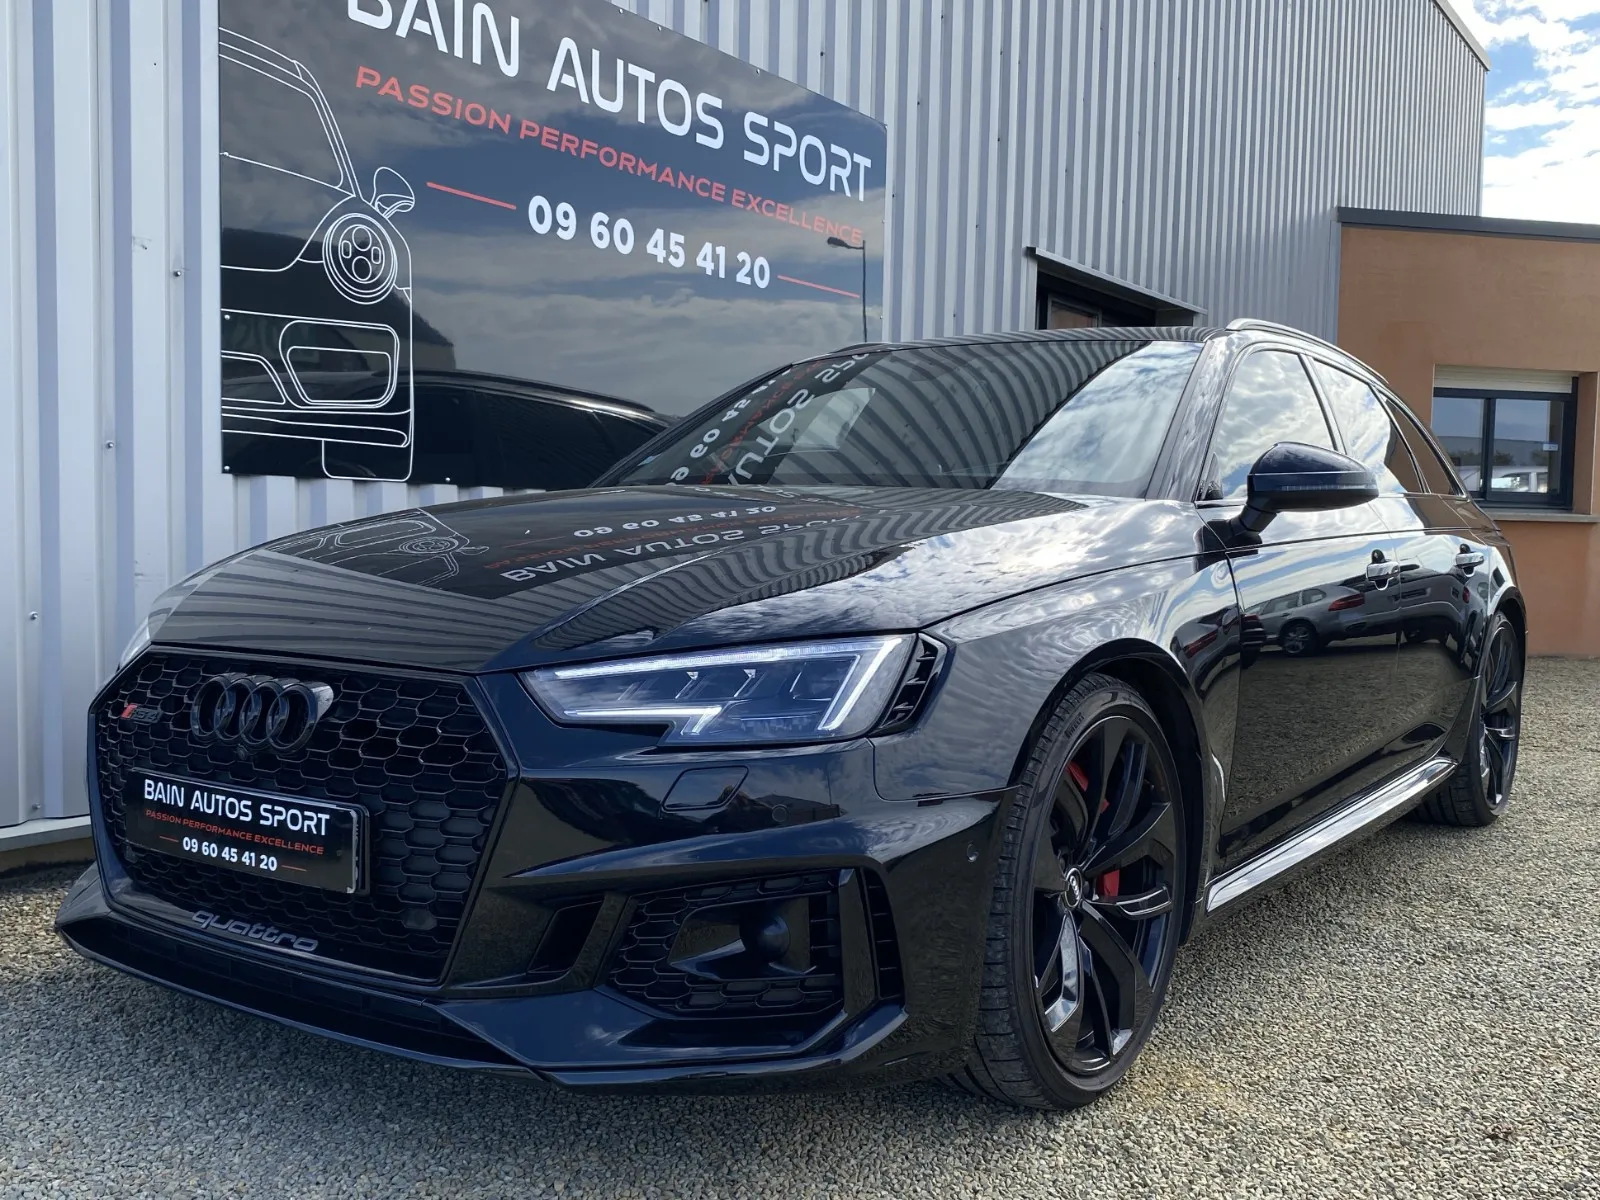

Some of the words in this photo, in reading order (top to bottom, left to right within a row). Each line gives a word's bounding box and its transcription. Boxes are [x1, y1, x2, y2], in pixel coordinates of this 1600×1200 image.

[546, 37, 725, 149] AUTOS
[743, 111, 872, 202] SPORT
[355, 66, 512, 134] PASSION
[519, 119, 726, 203] PERFORMANCE
[731, 188, 864, 246] EXCELLENCE
[528, 195, 577, 241] 09
[590, 211, 635, 255] 60
[646, 228, 685, 268] 45
[696, 241, 726, 279] 41
[736, 251, 770, 289] 20
[143, 779, 185, 808] BAIN
[190, 789, 253, 822] AUTOS
[259, 803, 331, 836] SPORT
[145, 809, 182, 825] PASSION
[182, 818, 252, 841] PERFORMANCE
[254, 834, 325, 855] EXCELLENCE
[182, 836, 199, 853] 09
[201, 841, 218, 858] 60
[221, 846, 238, 863] 45
[241, 851, 256, 867] 41
[259, 854, 278, 872] 20
[191, 910, 319, 952] quattro
